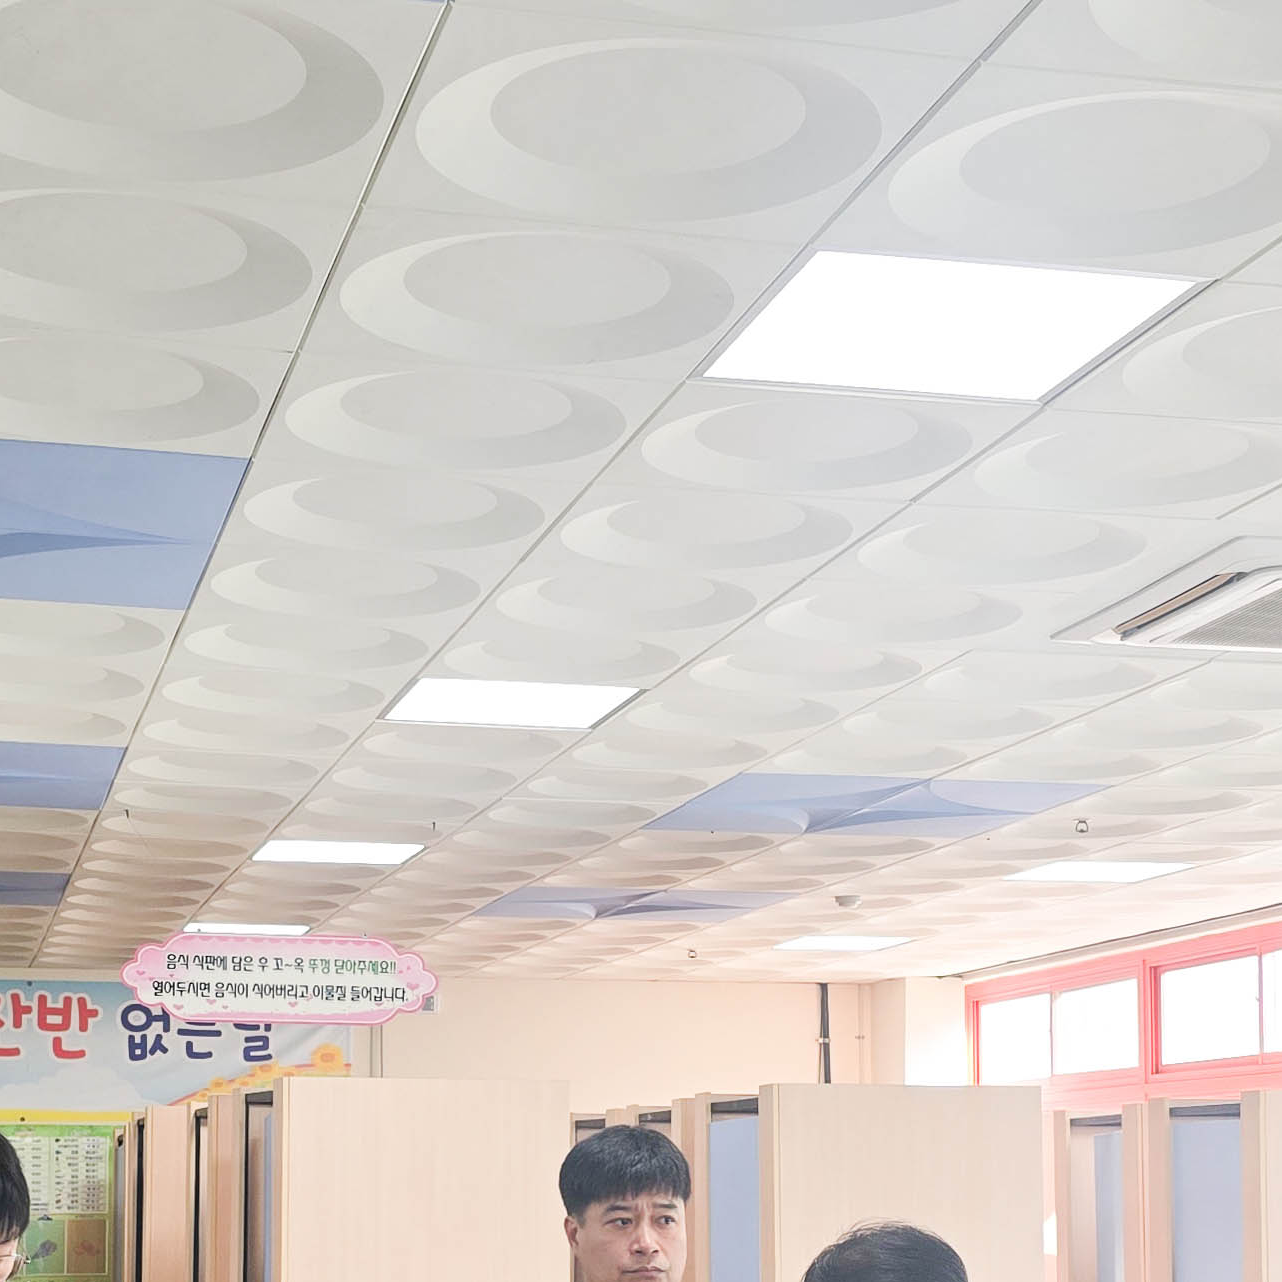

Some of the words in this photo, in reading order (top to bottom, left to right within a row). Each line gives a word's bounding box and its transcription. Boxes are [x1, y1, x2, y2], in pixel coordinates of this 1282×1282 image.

[166, 953, 189, 970] 음식
[192, 954, 228, 971] 식판에
[231, 955, 254, 972] 담은
[308, 958, 331, 975] 뚜껑
[334, 958, 397, 975] 닫아주세요!!
[152, 980, 211, 997] 열어두시면
[214, 982, 249, 998] 음식이
[252, 983, 309, 1000] 식어버리고
[312, 984, 347, 1001] 이물질
